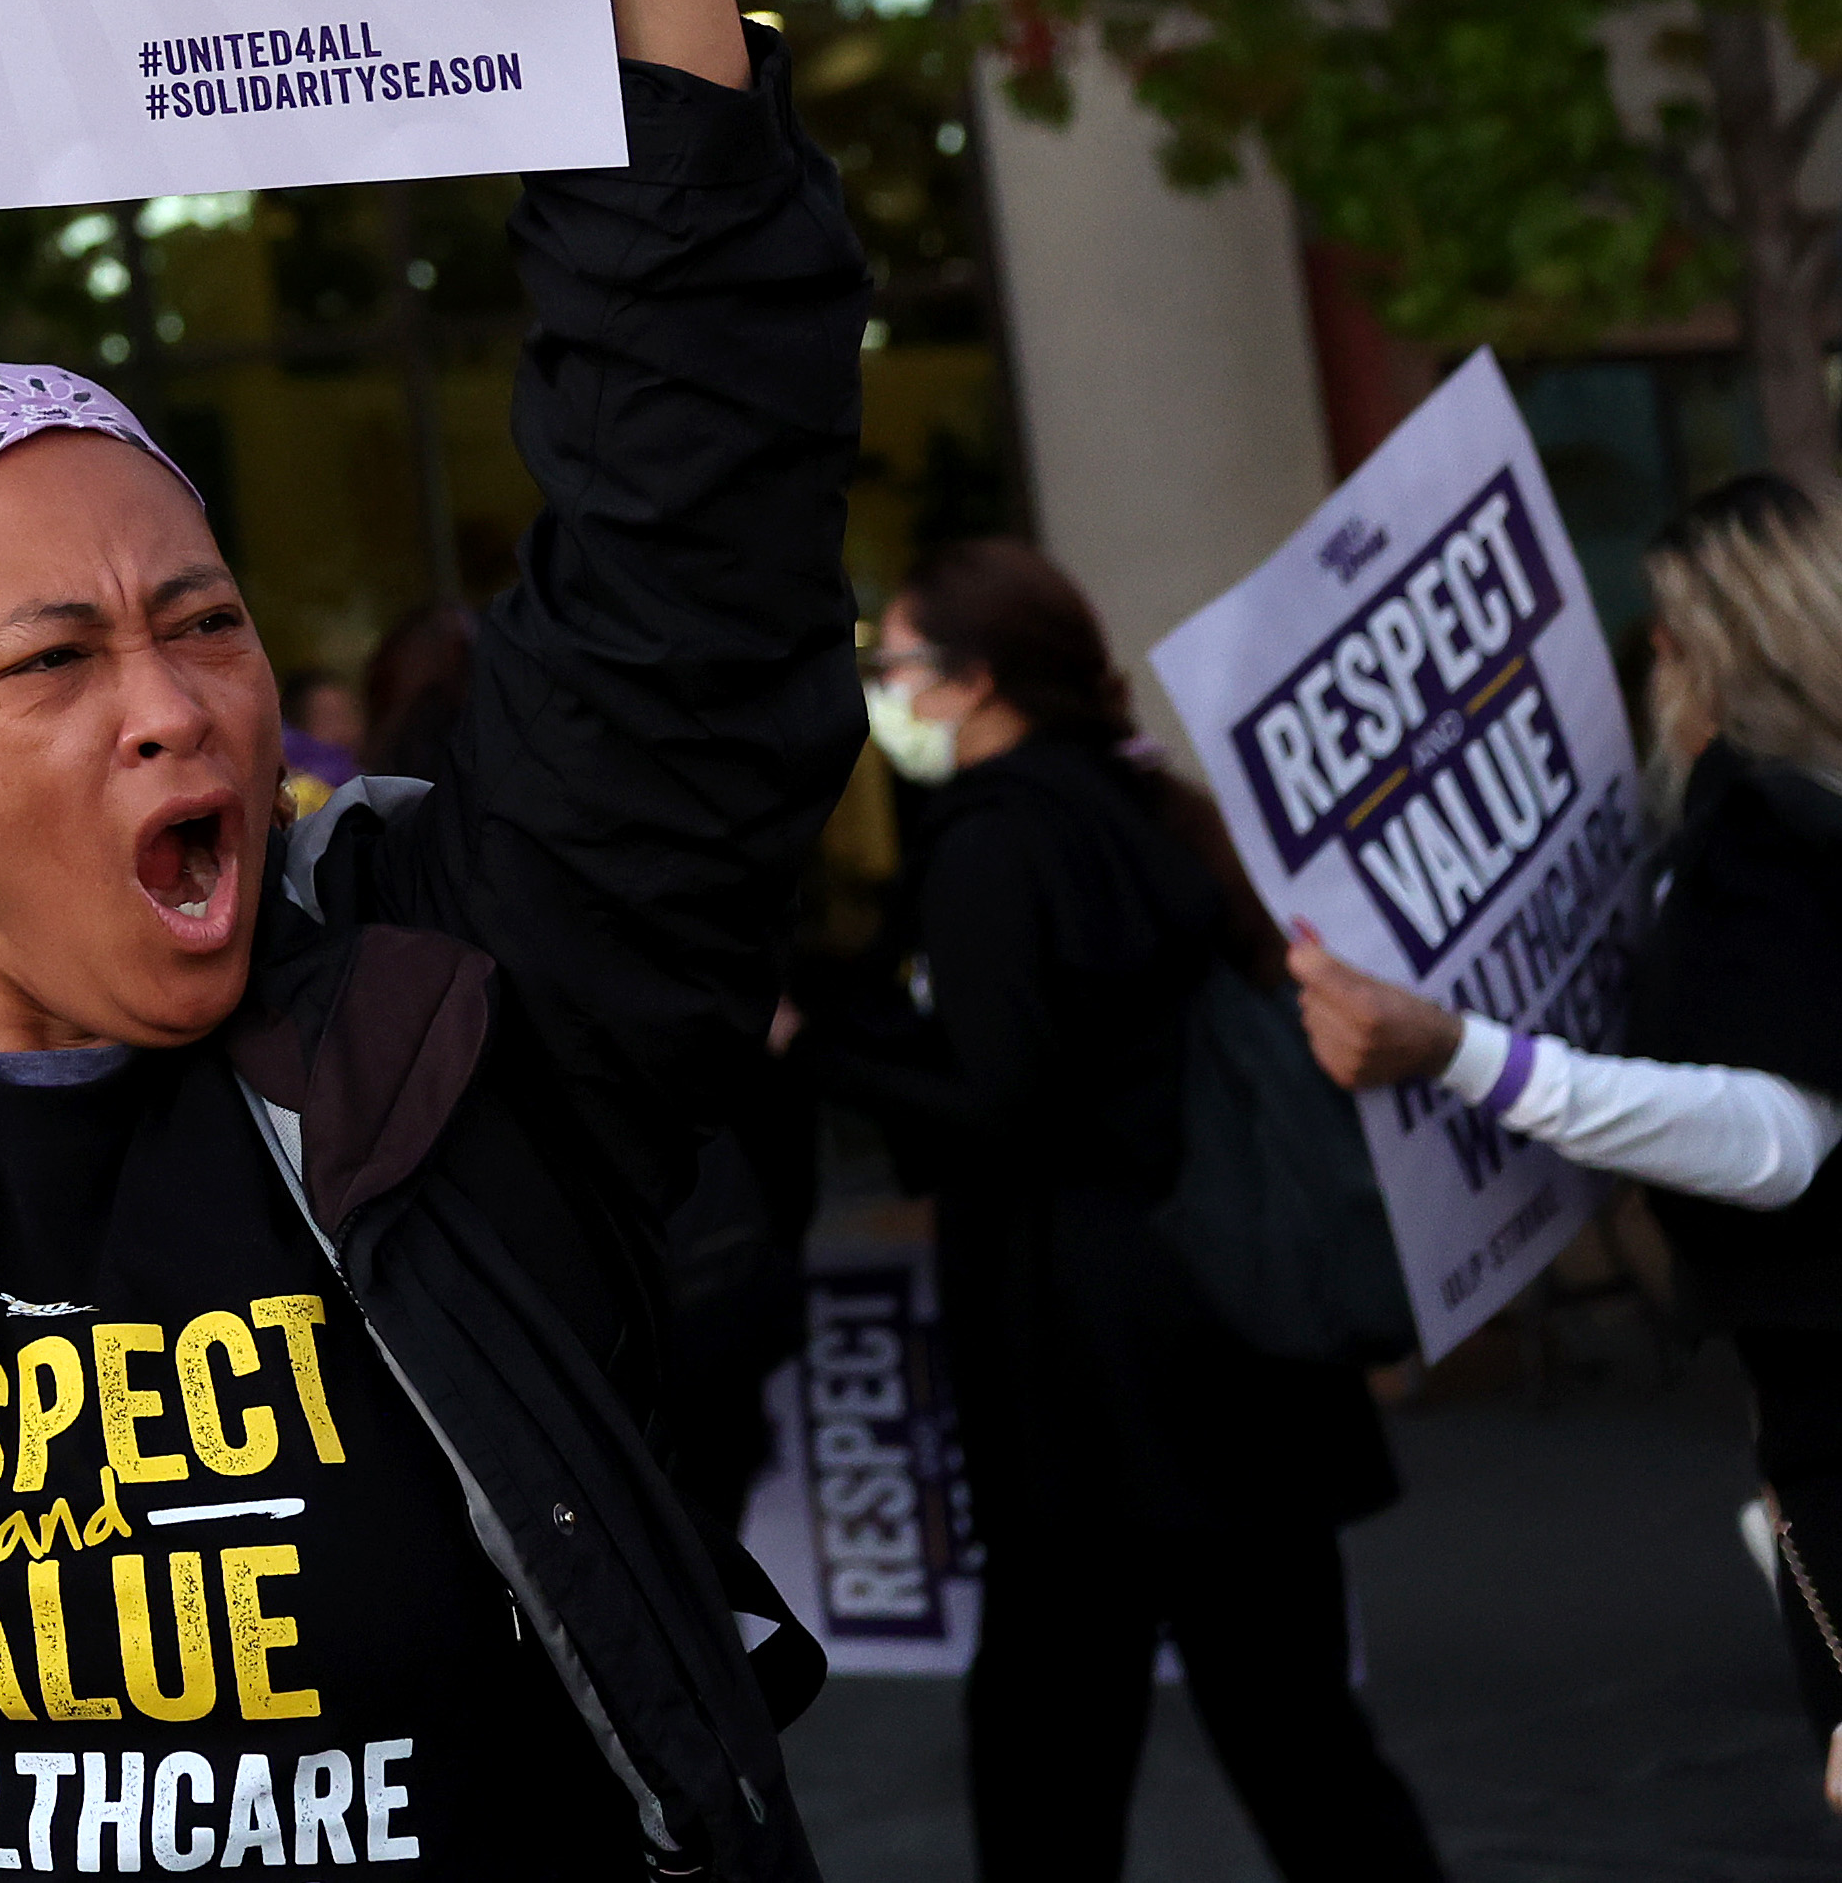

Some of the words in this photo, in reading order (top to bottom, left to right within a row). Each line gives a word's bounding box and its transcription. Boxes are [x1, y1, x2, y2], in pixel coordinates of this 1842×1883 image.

[138, 20, 382, 79] #UNITED4ALL
[145, 51, 524, 120] #SOLIDARITYSEASON
[1252, 492, 1538, 837] RESPECT
[1358, 683, 1575, 950] VALUE
